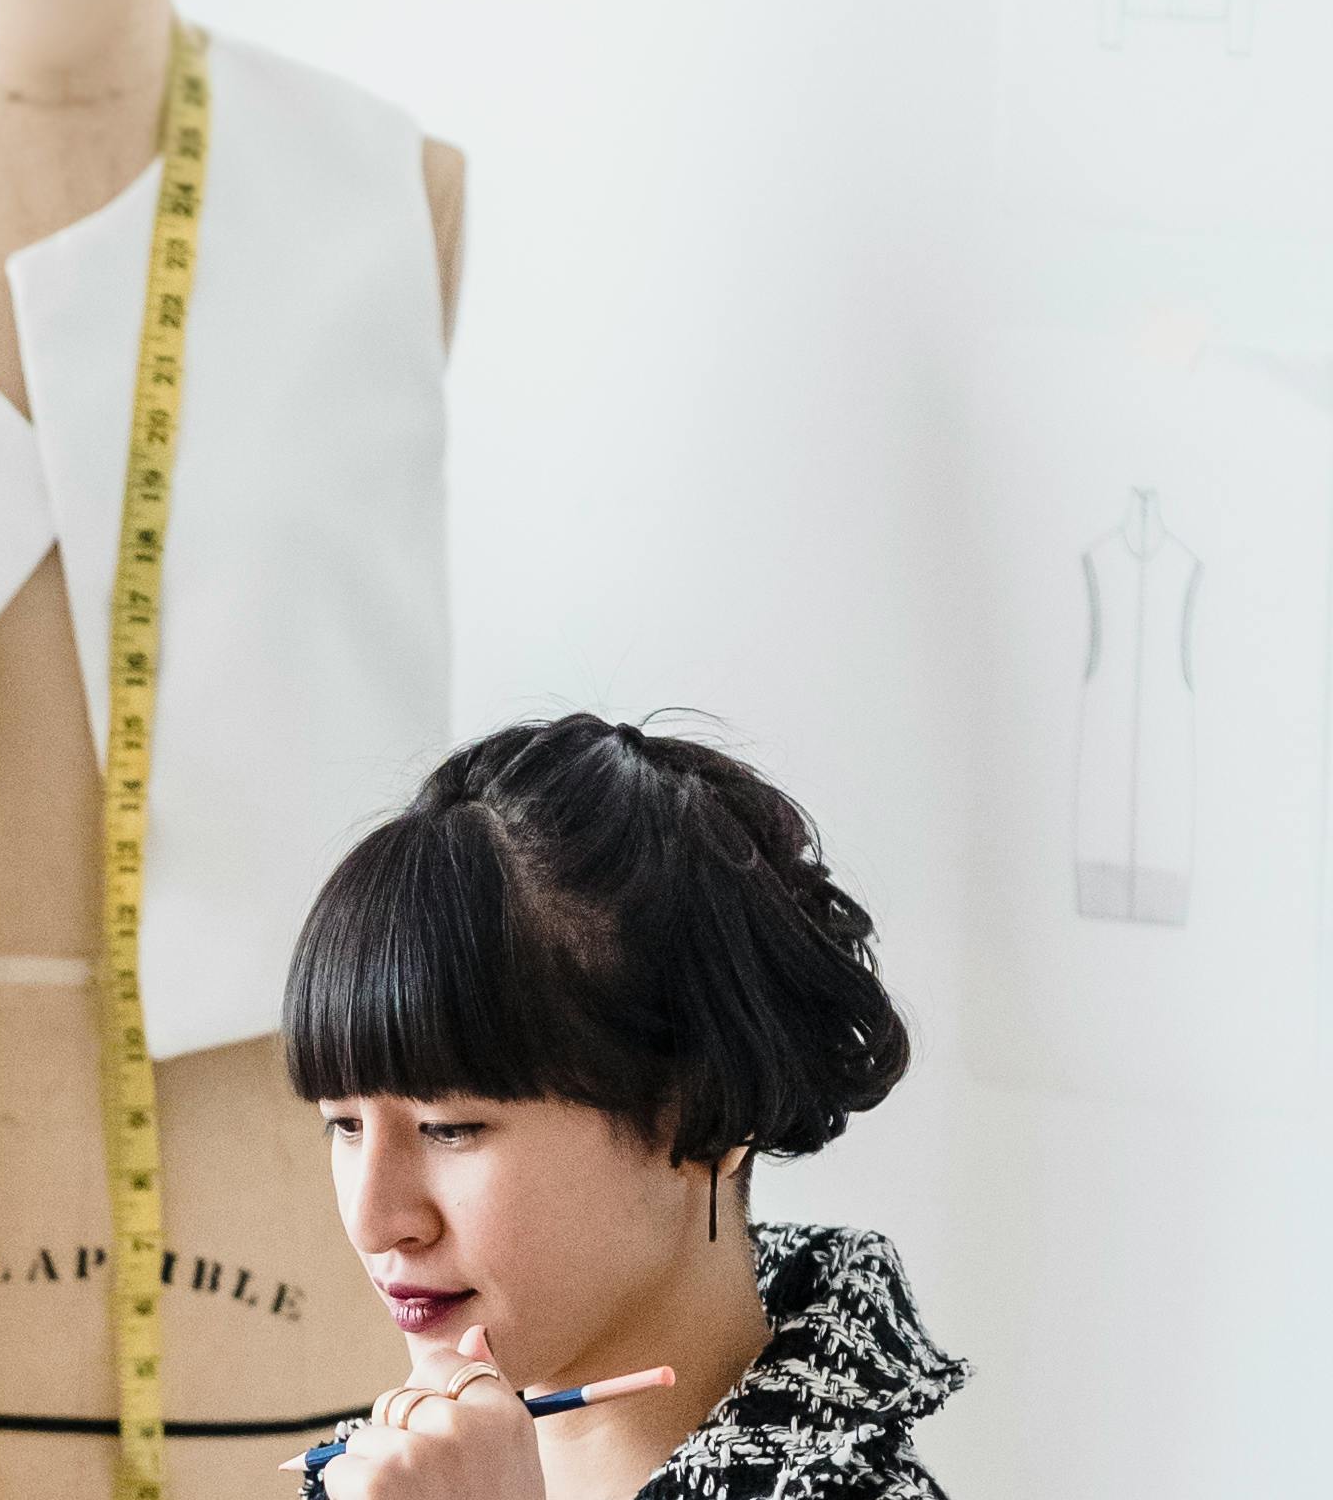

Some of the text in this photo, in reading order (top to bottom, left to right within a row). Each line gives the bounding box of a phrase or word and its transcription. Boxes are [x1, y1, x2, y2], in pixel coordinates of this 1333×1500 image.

[170, 182, 196, 218] 24
[158, 293, 185, 329] 22
[152, 355, 177, 387] 21
[146, 409, 171, 445] 20
[140, 469, 164, 503] 19
[128, 590, 152, 625] 17
